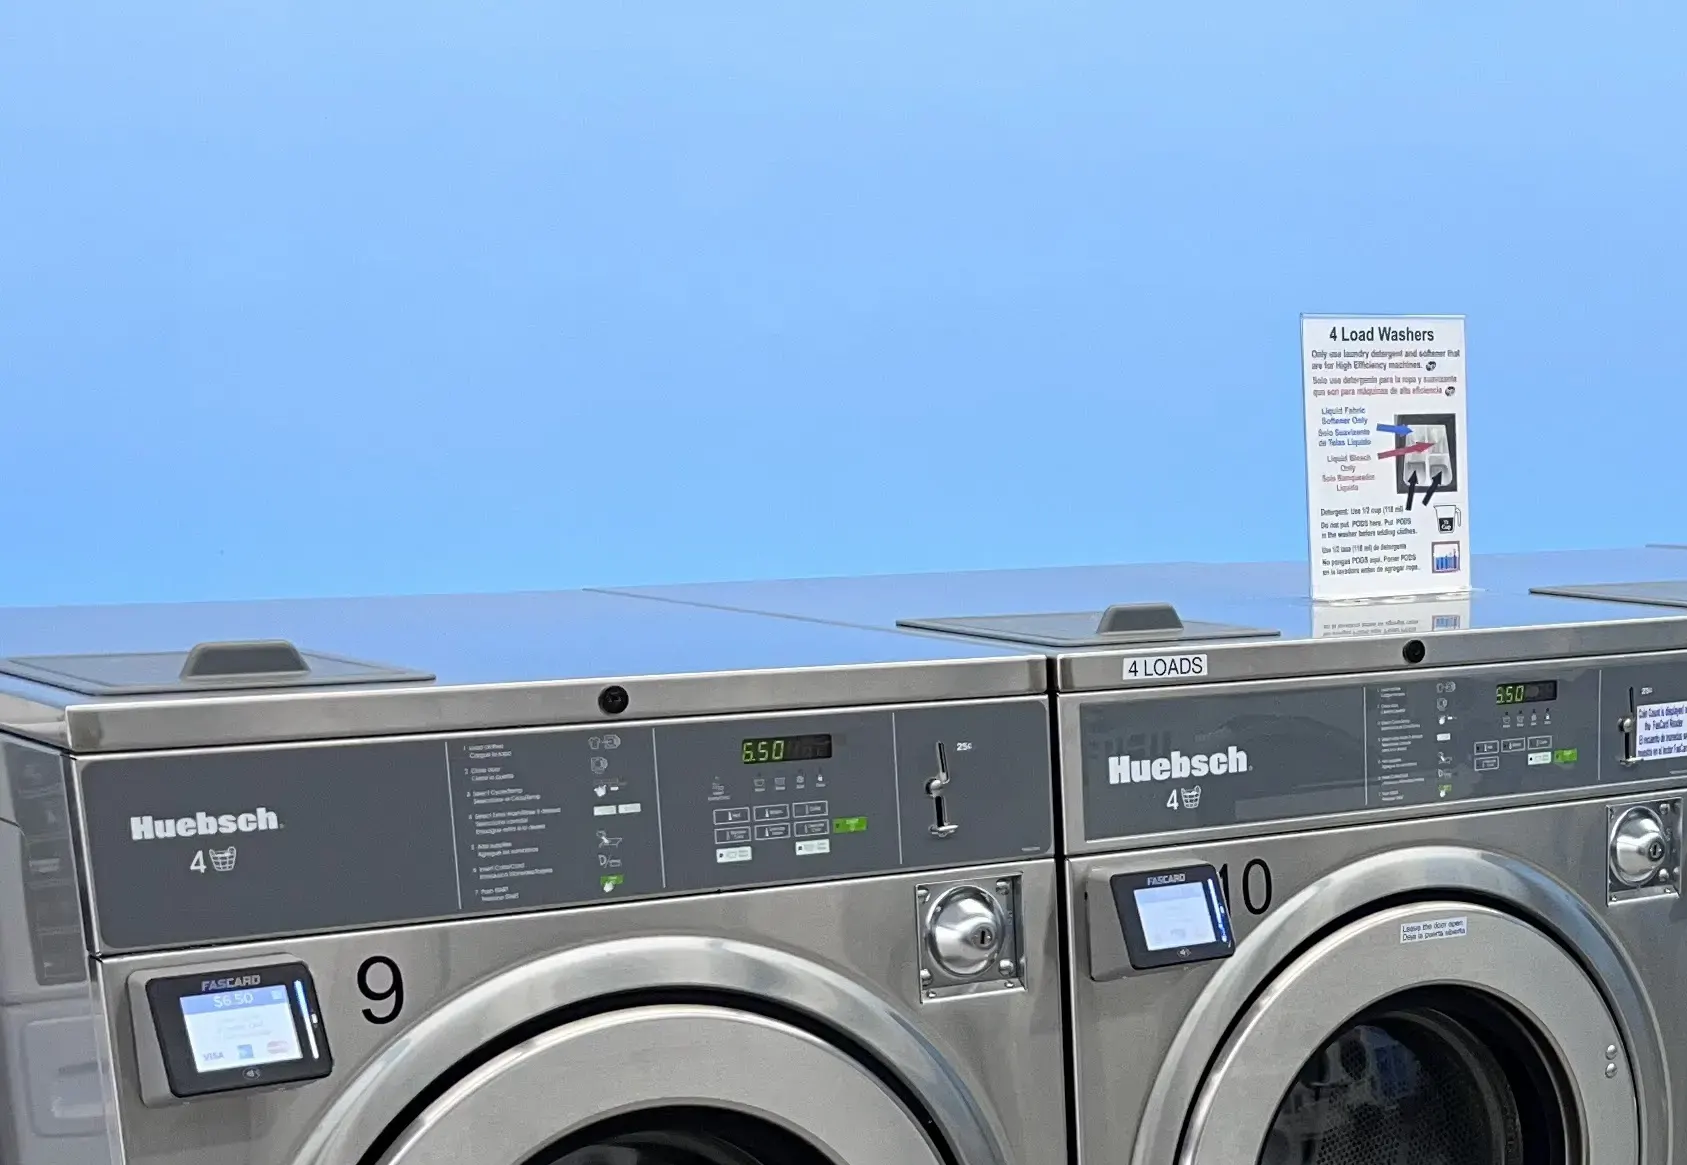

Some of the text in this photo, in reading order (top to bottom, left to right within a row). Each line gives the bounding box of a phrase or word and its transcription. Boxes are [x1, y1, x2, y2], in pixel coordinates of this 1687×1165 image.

[1329, 327, 1434, 341] 4 Load Washers
[1312, 350, 1327, 359] Only
[1344, 350, 1368, 359] laundry
[1371, 350, 1402, 359] detergent
[1448, 349, 1460, 357] that
[1325, 361, 1334, 369] for
[1336, 361, 1352, 371] High
[1354, 361, 1386, 371] Efficiency
[1341, 388, 1355, 396] para
[1352, 417, 1368, 425] Only
[1129, 657, 1203, 676] 4 LOADS
[743, 740, 784, 762] 6.50
[1109, 746, 1248, 784] Huebsch
[1167, 789, 1179, 810] 4
[130, 807, 278, 840] Huebsch
[190, 850, 207, 873] 4
[1147, 873, 1185, 886] FASCARD
[1219, 858, 1272, 917] 10
[202, 975, 260, 991] FASCARD
[357, 955, 404, 1025] 9
[204, 1052, 225, 1060] VISA
